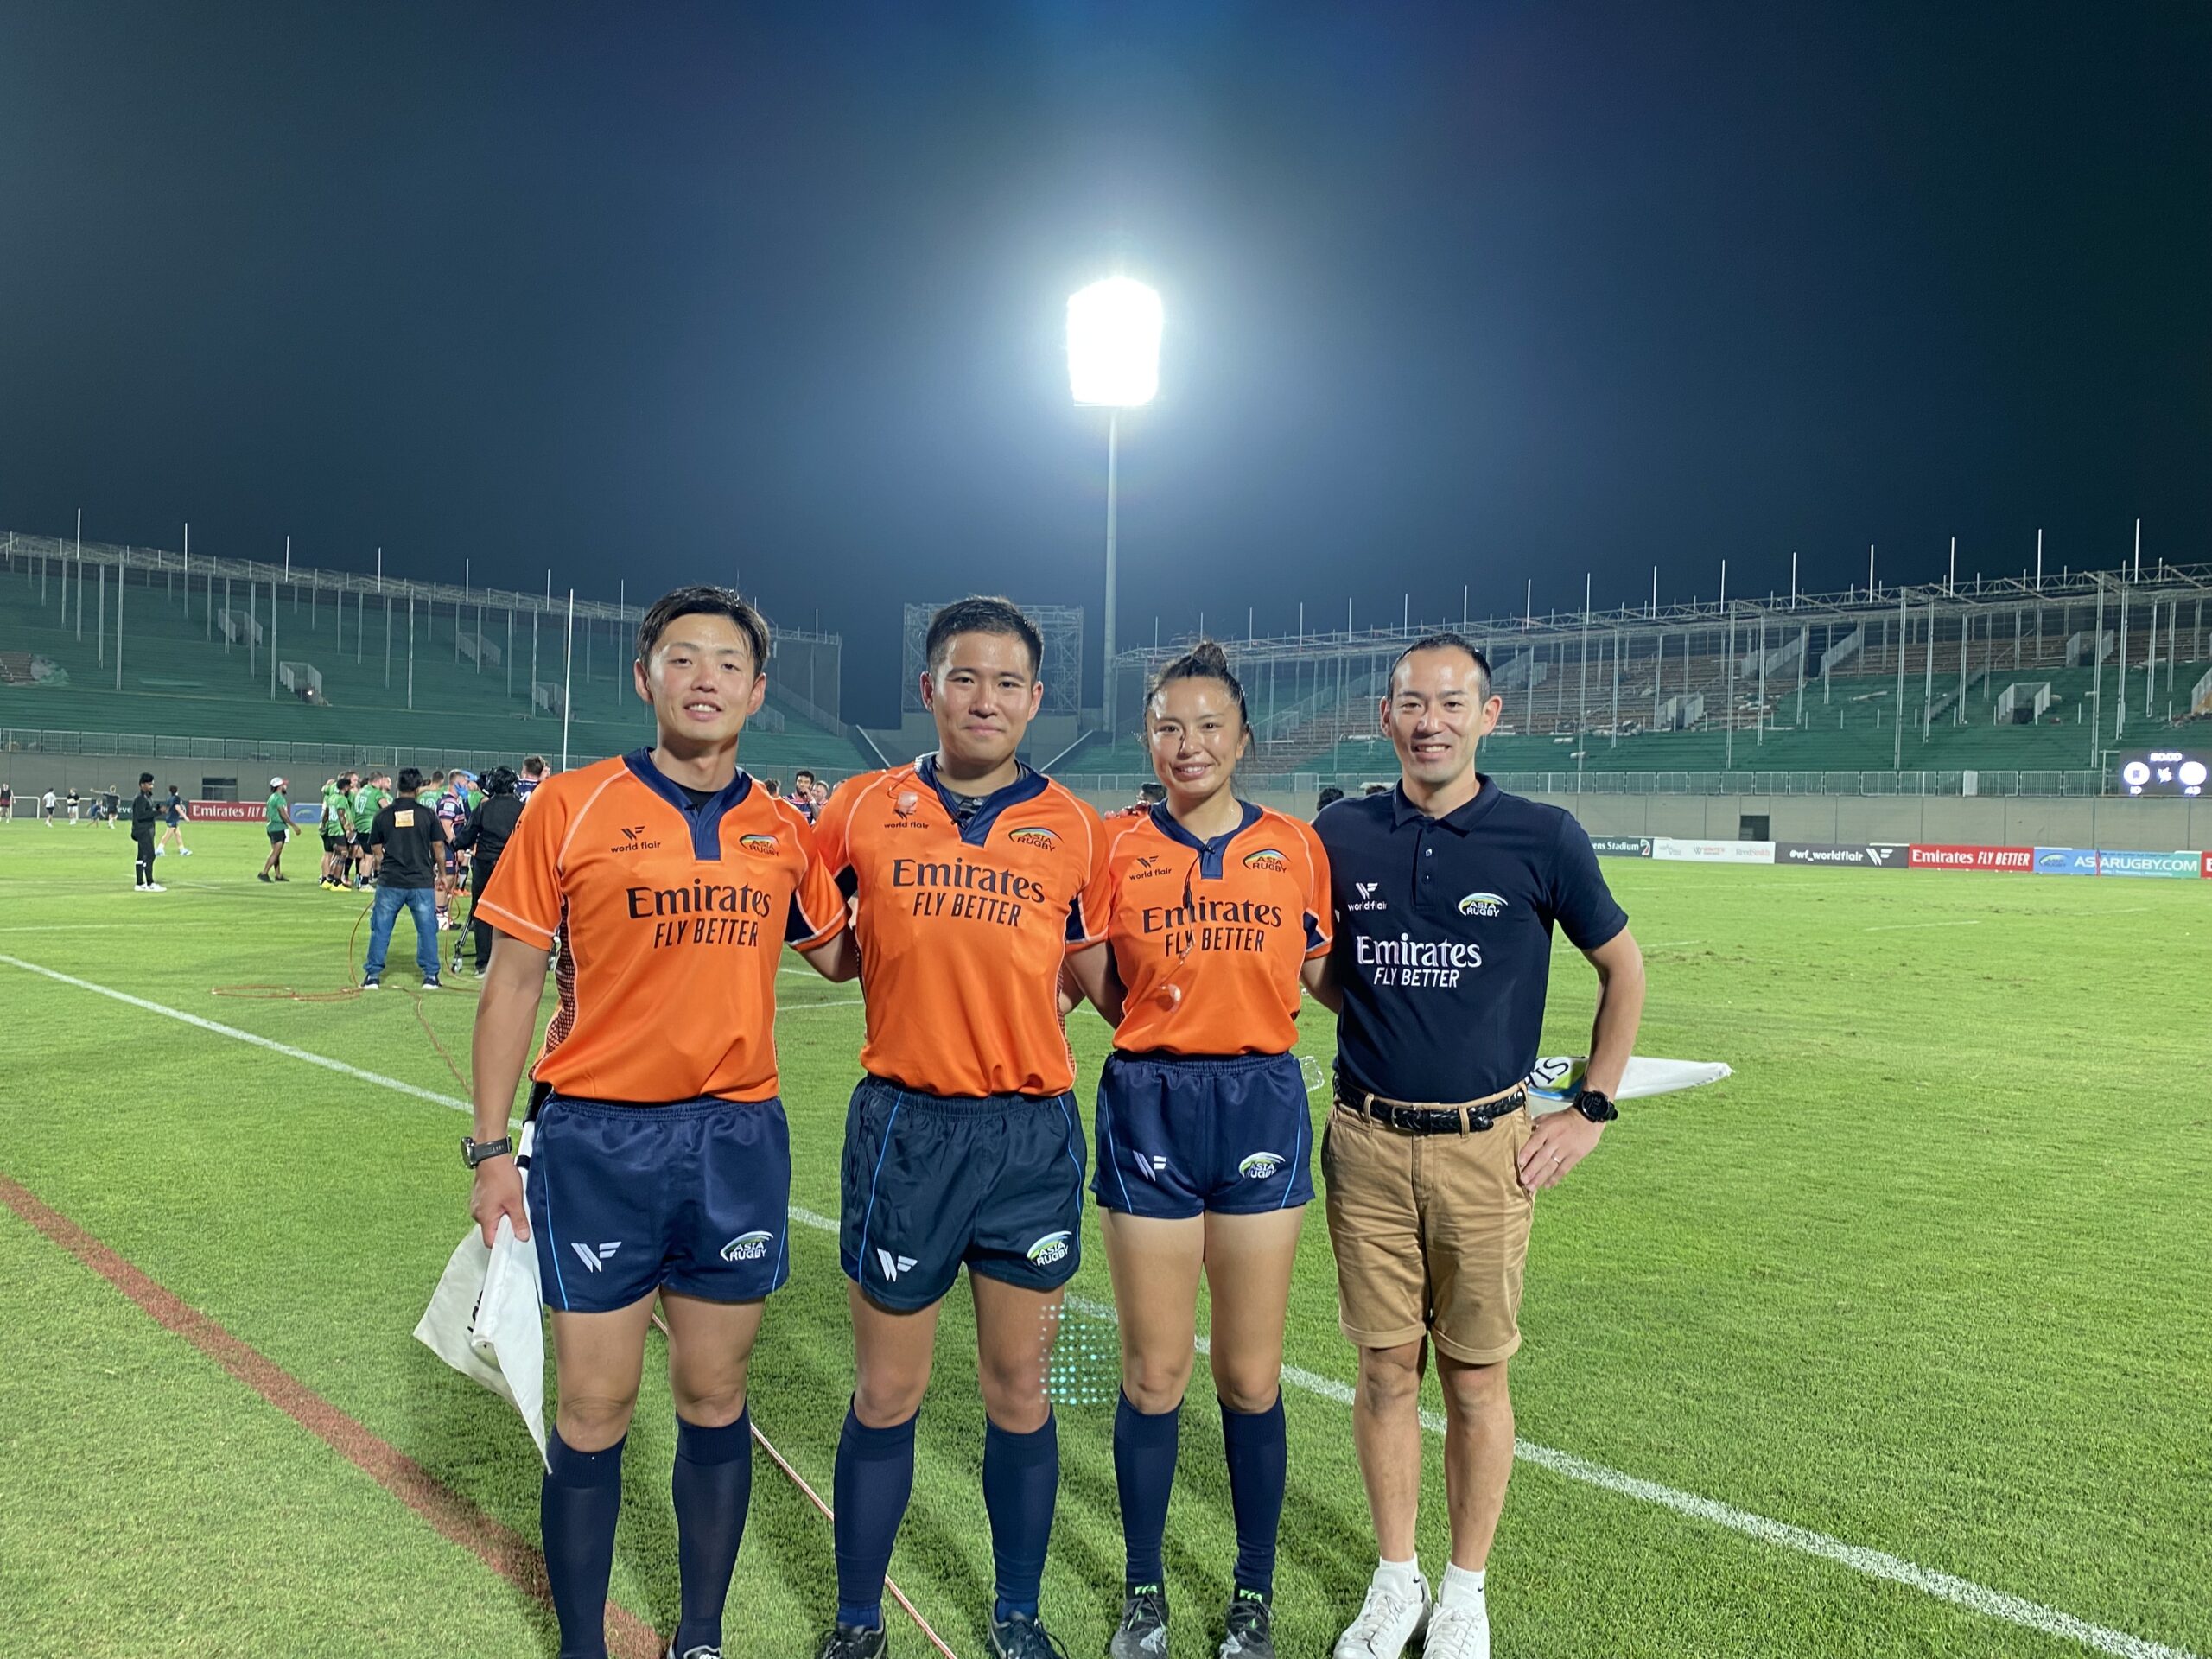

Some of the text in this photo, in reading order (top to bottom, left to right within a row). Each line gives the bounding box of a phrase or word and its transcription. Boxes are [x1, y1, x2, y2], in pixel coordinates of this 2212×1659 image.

[193, 805, 244, 817] Emirates
[247, 807, 260, 817] FLY
[1017, 836, 1056, 852] RUGBY
[1023, 833, 1052, 844] ASIA
[611, 841, 661, 853] world flair
[1607, 842, 1639, 851] Stadium
[1256, 855, 1282, 865] ASIA
[1912, 849, 2031, 866] Emirates FLY BETTER
[2075, 856, 2198, 871] ASARUGBY.COM
[1129, 868, 1172, 880] world flair
[1253, 862, 1287, 874] RUGBY
[893, 857, 1045, 903] Emirates
[626, 878, 772, 919] Emirates
[912, 893, 1021, 927] FLY BETTER
[1348, 901, 1387, 911] world flair
[1466, 907, 1500, 917] RUGBY
[1142, 896, 1282, 934] Emirates
[654, 918, 759, 949] FLY BETTER
[1201, 927, 1264, 952] BETTER
[1357, 932, 1482, 968] Emirates
[1374, 967, 1459, 988] FLY BETTER
[1249, 1162, 1274, 1171] ASIA
[734, 1241, 764, 1251] ASIA
[1039, 1241, 1066, 1255] ASIA
[729, 1248, 766, 1261] RUGBY
[1037, 1245, 1069, 1267] RUGBY
